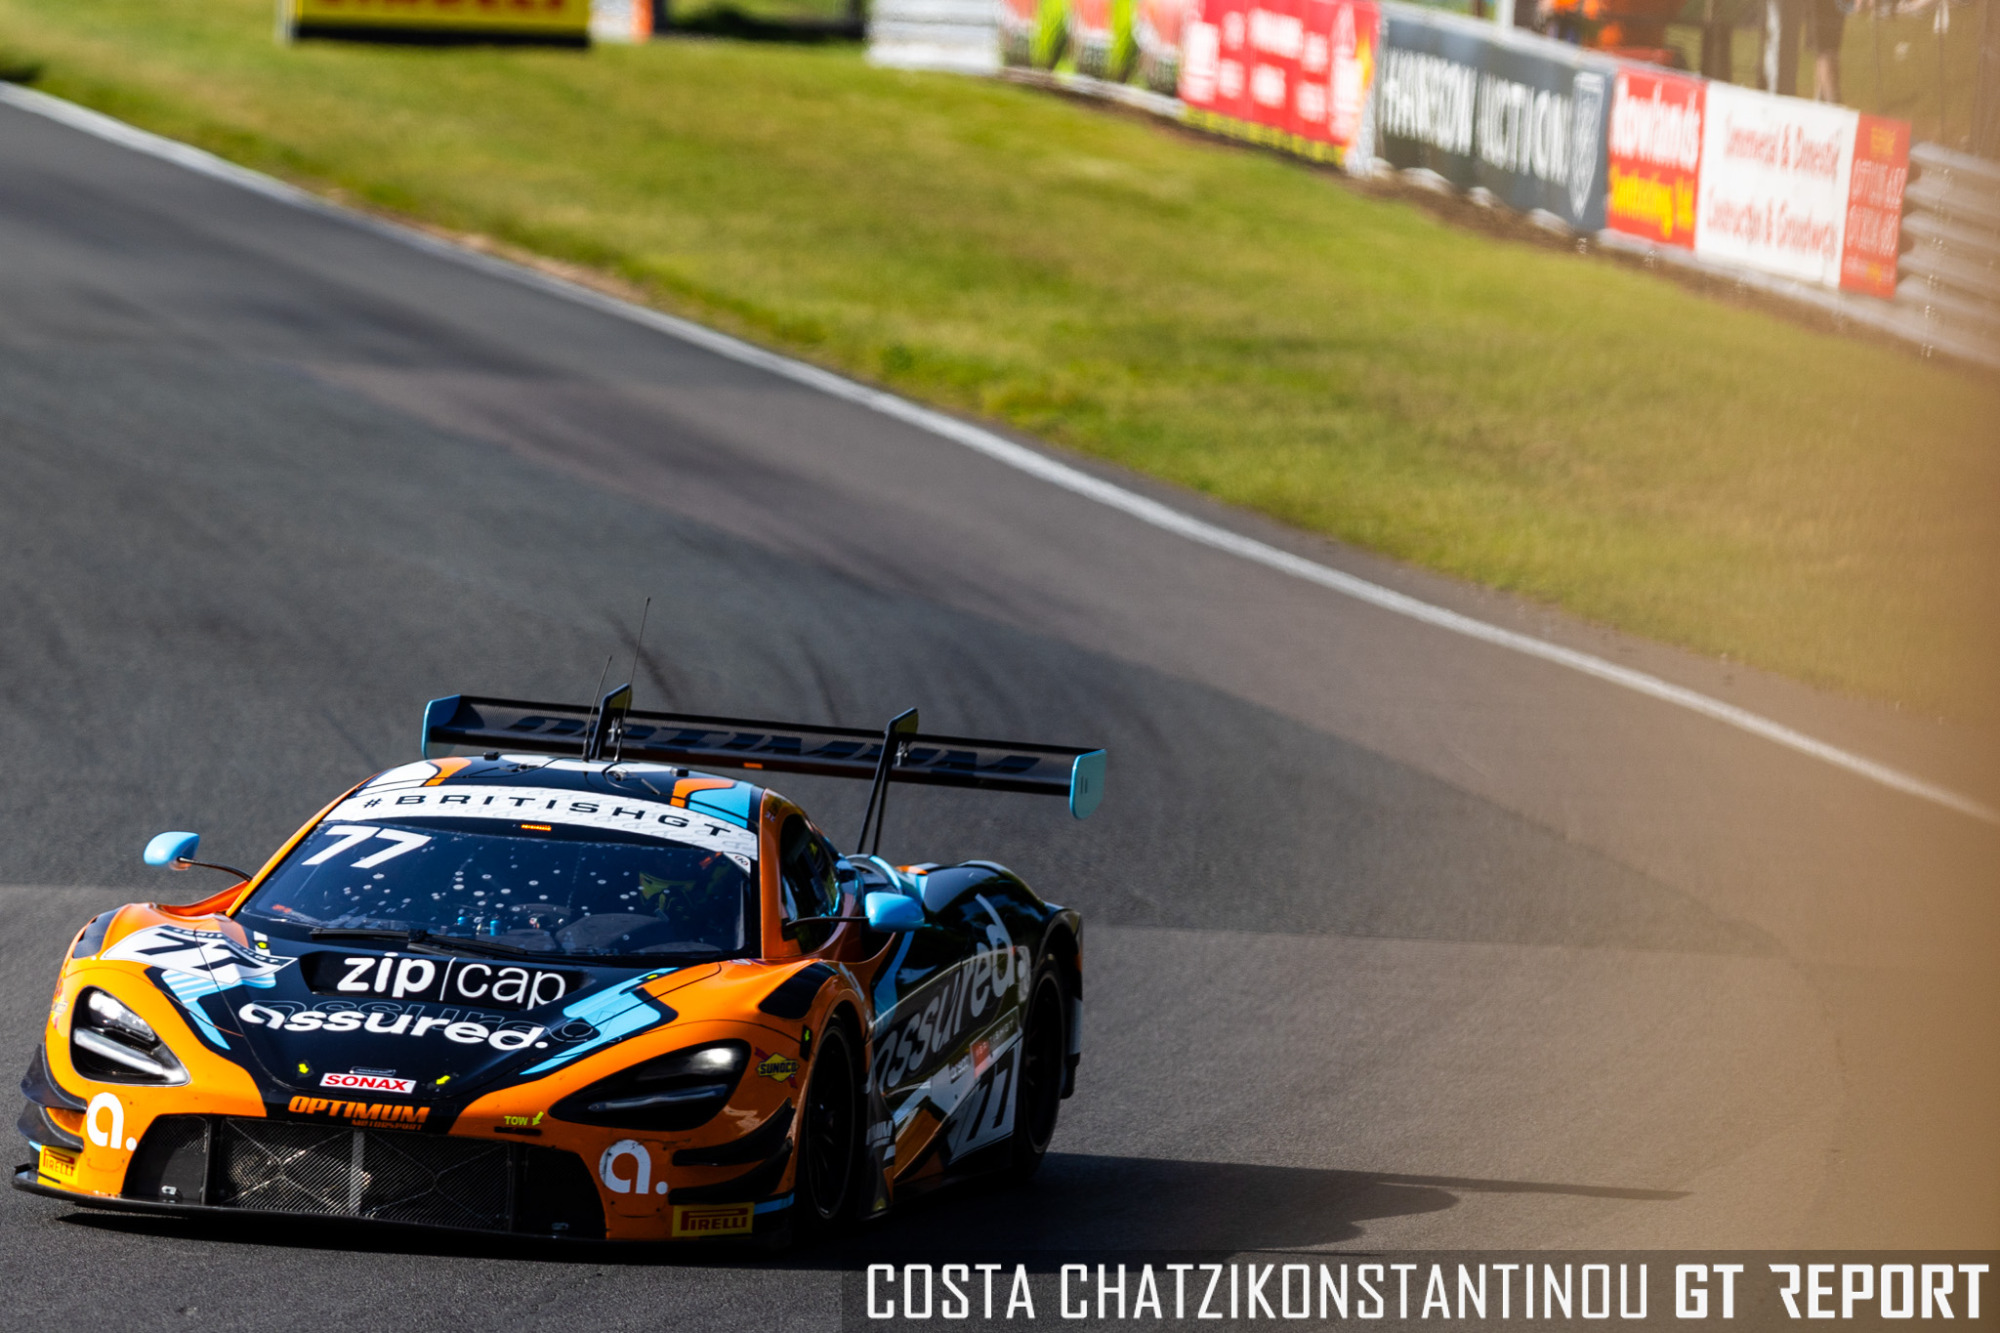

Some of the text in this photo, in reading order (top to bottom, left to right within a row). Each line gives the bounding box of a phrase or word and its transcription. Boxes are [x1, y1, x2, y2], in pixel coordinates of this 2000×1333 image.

[363, 794, 731, 837] #BRITISHGT
[301, 825, 433, 868] 77
[238, 1003, 549, 1051] assured.
[759, 1062, 798, 1075] SUNOCO
[324, 1075, 409, 1092] SONAX
[288, 1095, 431, 1123] OPTIMUM
[504, 1115, 529, 1127] TOW
[351, 1119, 424, 1131] MOTORSPORT
[43, 1147, 76, 1177] PIRELLI
[680, 1207, 749, 1231] PIRELLI
